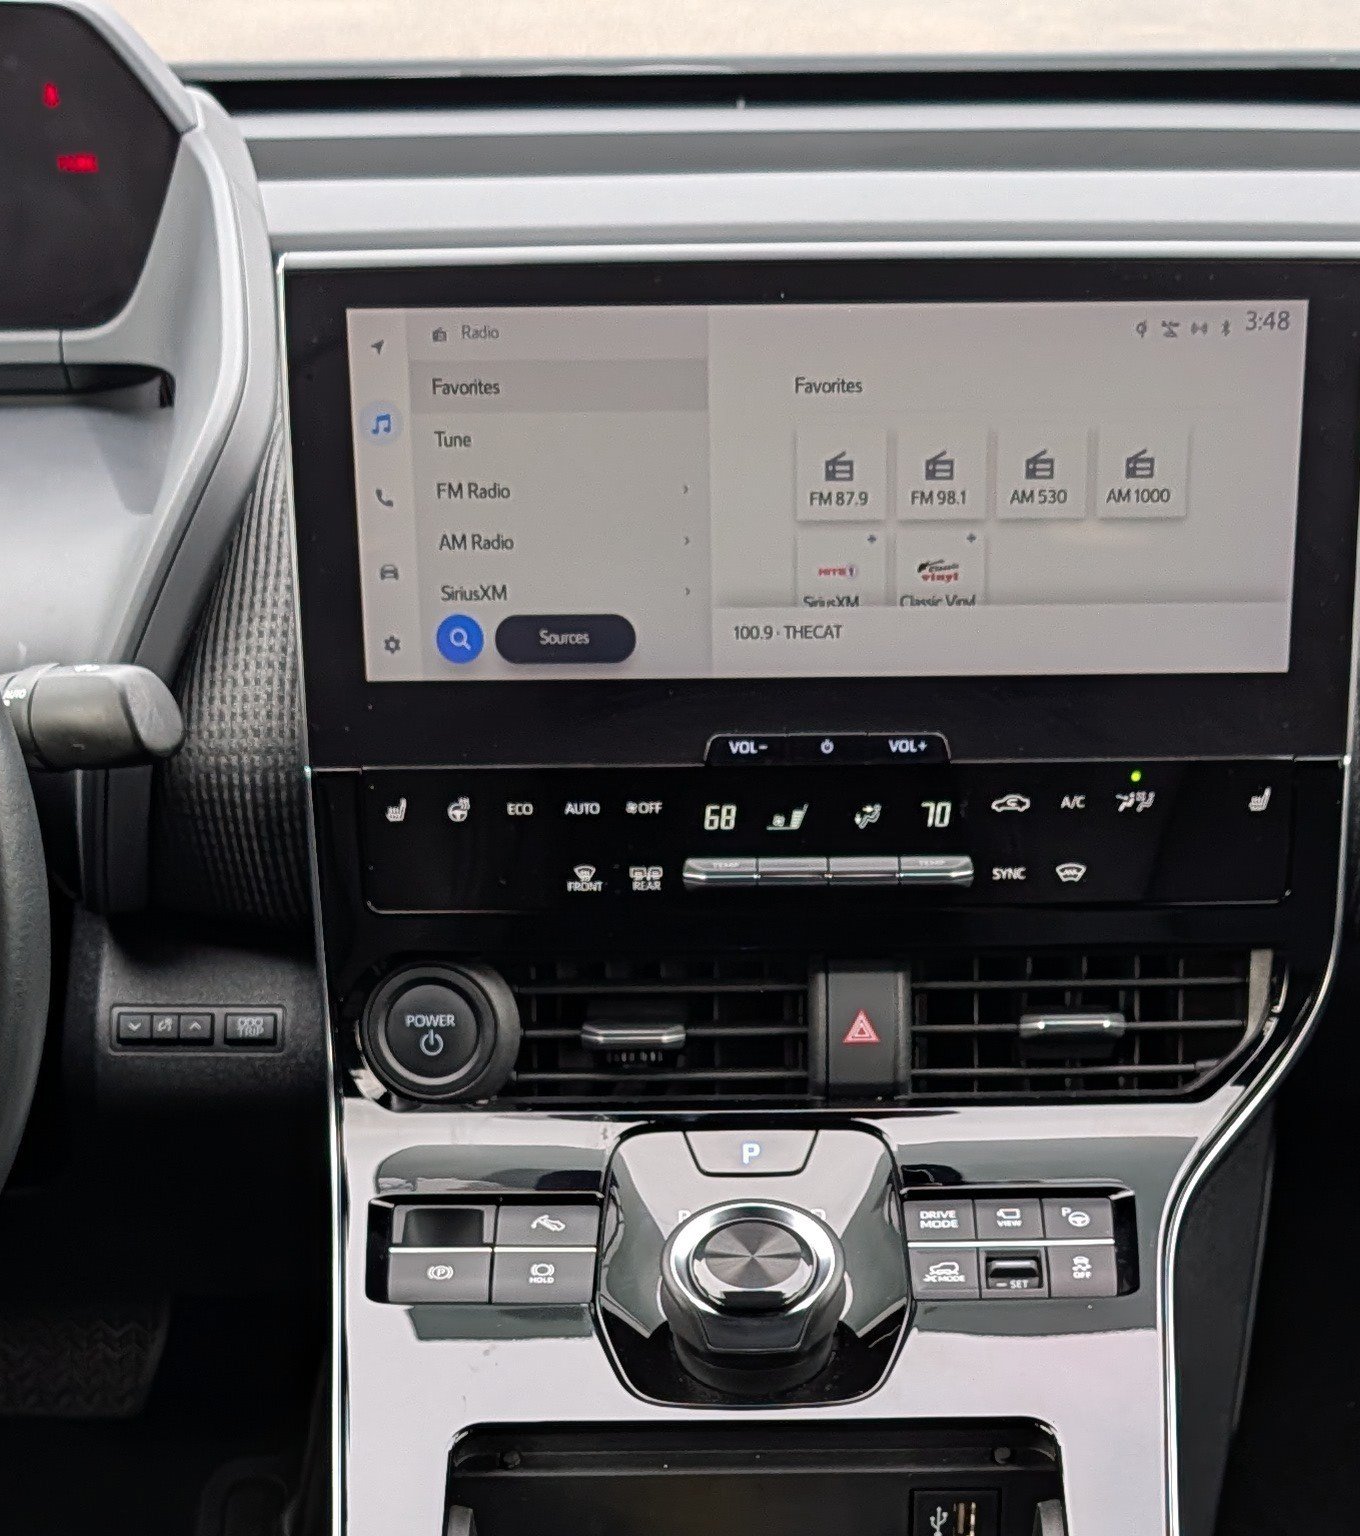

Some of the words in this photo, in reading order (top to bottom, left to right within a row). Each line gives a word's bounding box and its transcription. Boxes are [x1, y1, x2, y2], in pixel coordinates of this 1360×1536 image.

[1245, 310, 1290, 331] 3:48
[460, 324, 500, 341] Radio
[431, 377, 500, 397] Favorites
[794, 375, 863, 395] Favorites
[434, 430, 472, 449] Tune
[436, 482, 464, 500] FM
[467, 481, 511, 500] Radio
[809, 491, 833, 507] FM
[834, 490, 869, 507] 87.9
[910, 490, 934, 506] FM
[935, 490, 967, 506] 98.1
[1010, 489, 1037, 505] AM
[1038, 489, 1068, 505] 530
[1106, 488, 1132, 504] AM
[1133, 488, 1171, 504] 1000
[439, 534, 468, 552] AM
[471, 534, 515, 552] Radio
[440, 584, 508, 602] SiriusXM
[539, 629, 590, 647] Sources
[733, 625, 773, 642] 100.9
[784, 624, 842, 641] THECAT
[507, 802, 533, 816] ECO
[564, 801, 601, 815] AUTO
[638, 801, 663, 815] OFF
[1060, 794, 1086, 810] A/C
[703, 804, 737, 831] 68
[921, 802, 951, 828] 70
[992, 867, 1026, 880] SYNC
[567, 880, 603, 892] FRONT
[632, 880, 661, 891] REAR
[405, 1014, 456, 1028] POWER
[742, 1142, 761, 1164] P
[919, 1210, 956, 1219] DRIVE
[919, 1220, 959, 1229] MODE
[996, 1219, 1022, 1227] VIEW
[528, 1276, 555, 1284] HOLD
[1072, 1270, 1092, 1279] OFF
[1009, 1279, 1029, 1289] SET
